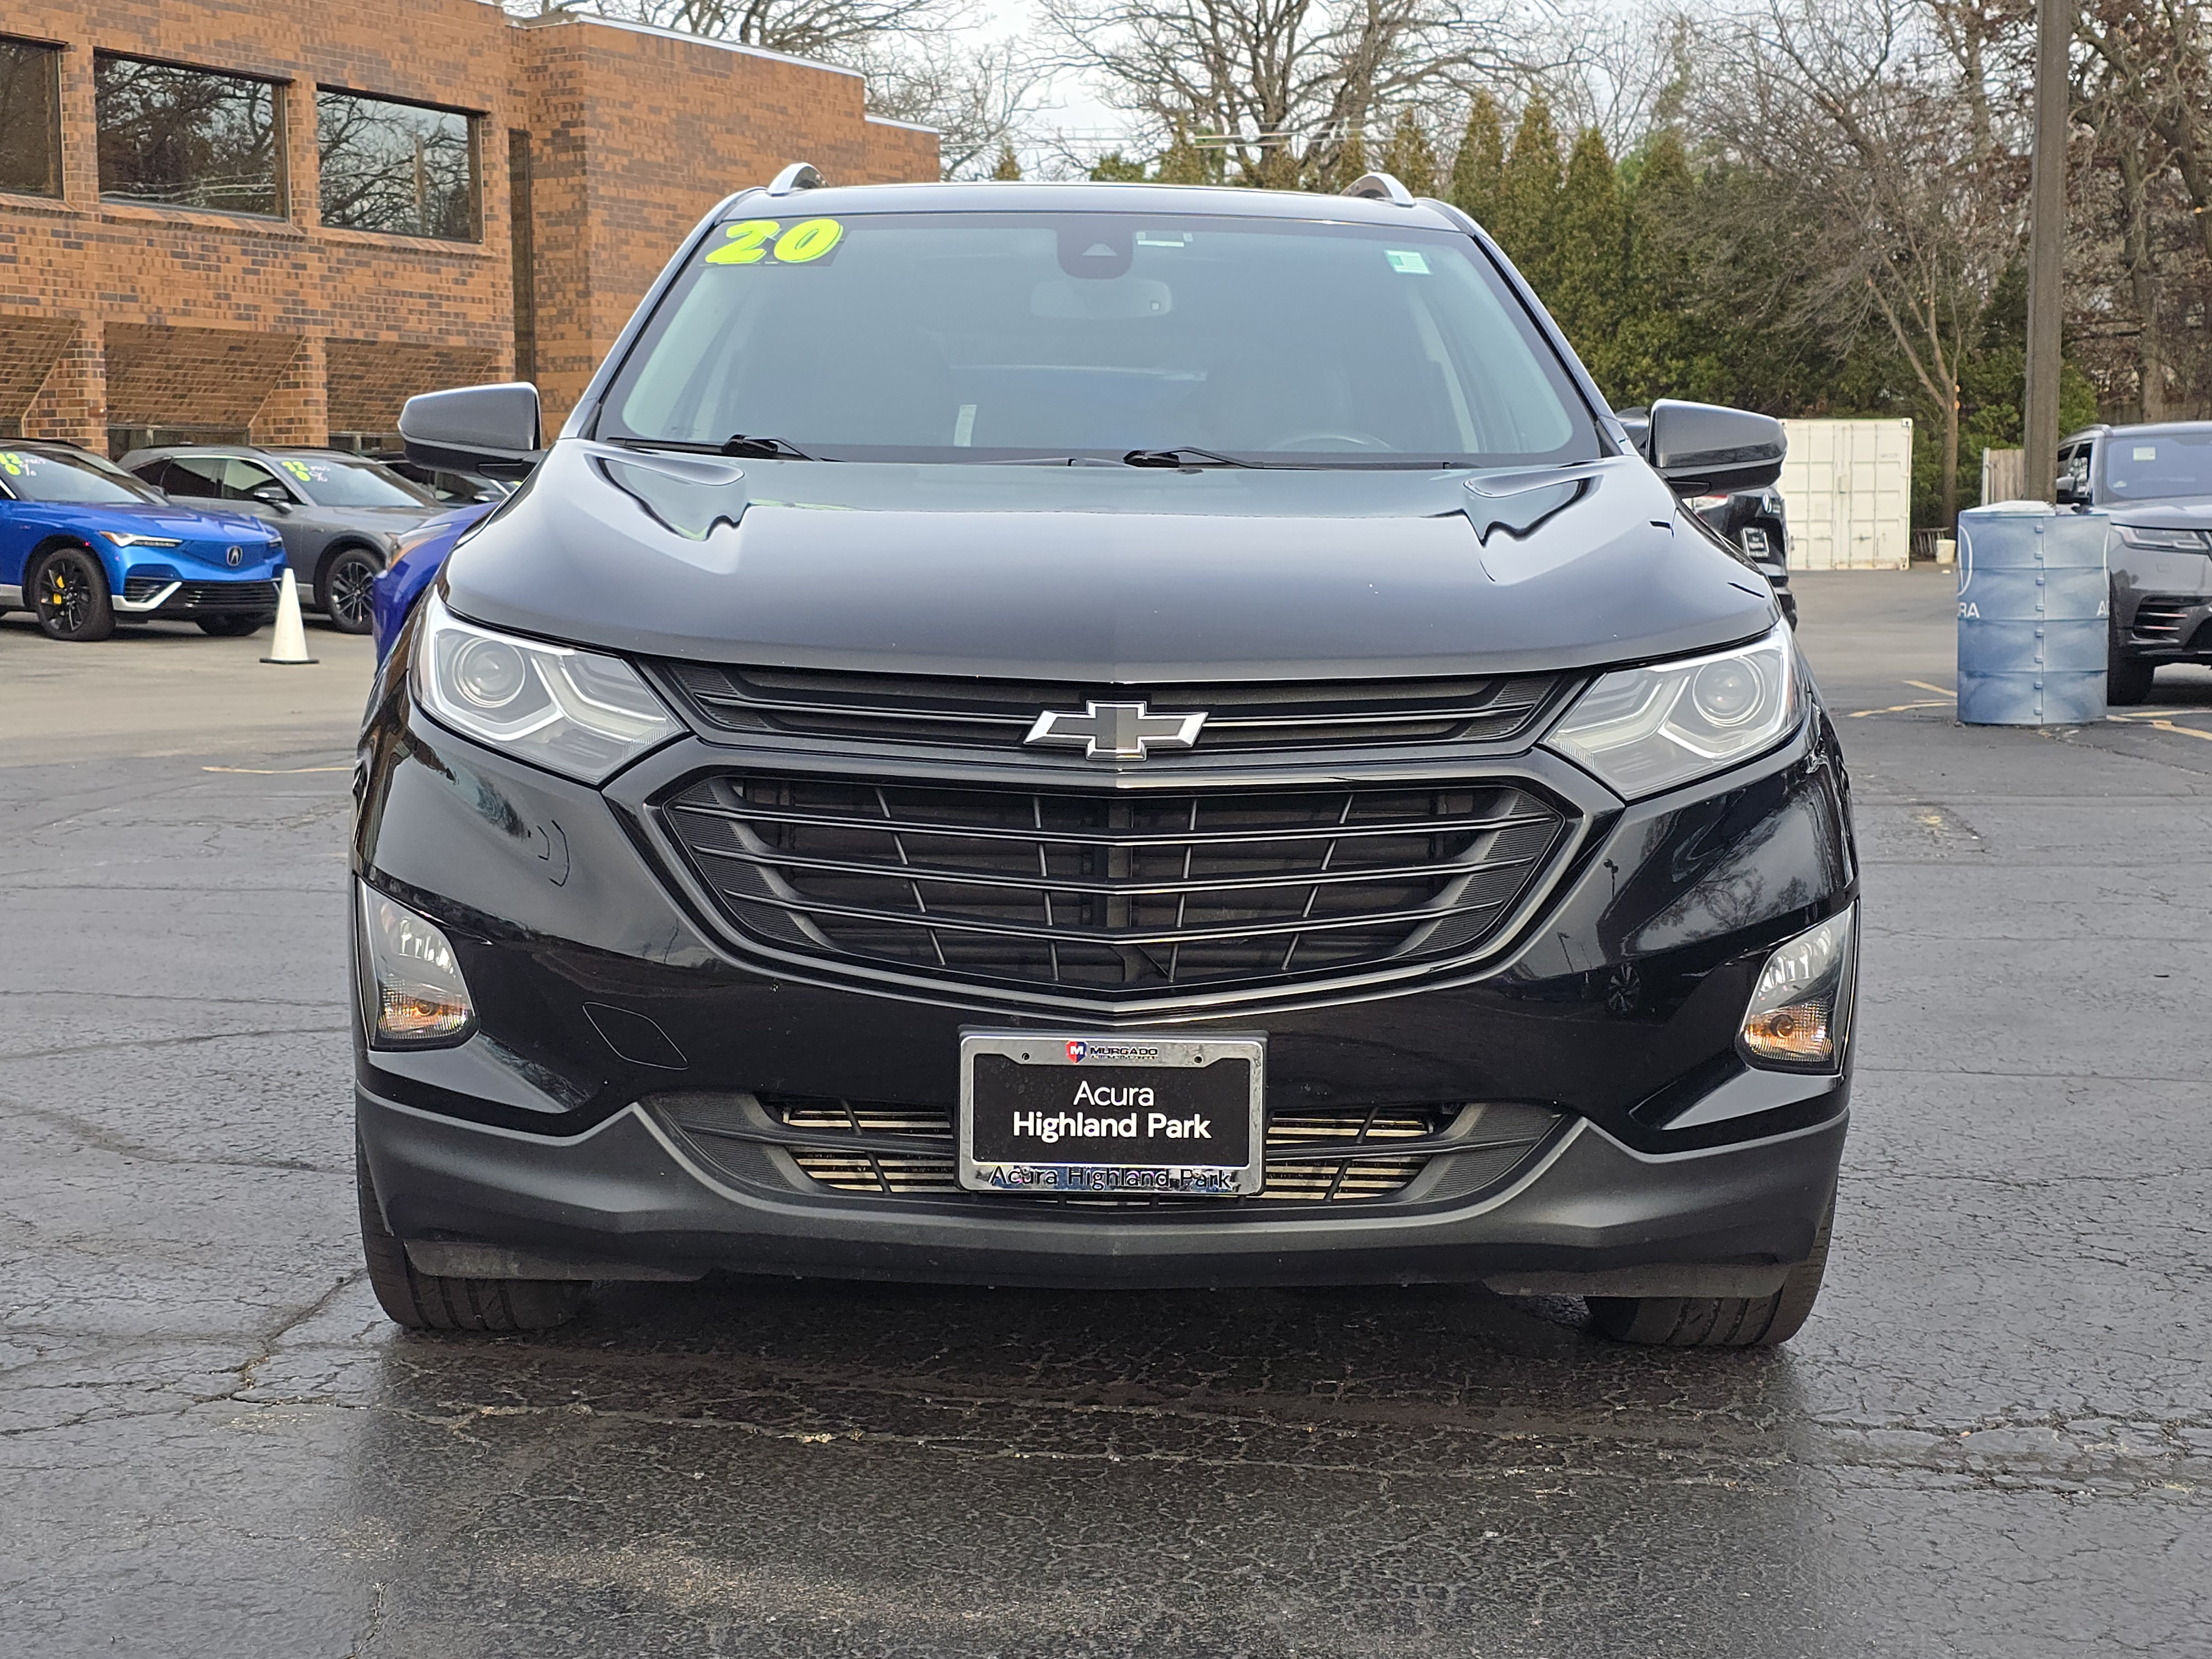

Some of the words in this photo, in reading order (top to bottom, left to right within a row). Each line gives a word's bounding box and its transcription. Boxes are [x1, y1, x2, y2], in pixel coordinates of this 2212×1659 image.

[705, 219, 843, 264] 20
[281, 461, 309, 472] 12
[1090, 1047, 1159, 1056] MURGADO
[1073, 1081, 1155, 1107] Acura
[1013, 1112, 1137, 1143] Highland
[1147, 1113, 1212, 1139] Park
[989, 1165, 1057, 1186] Acura
[1067, 1166, 1170, 1191] Highland
[1180, 1168, 1232, 1190] Park
